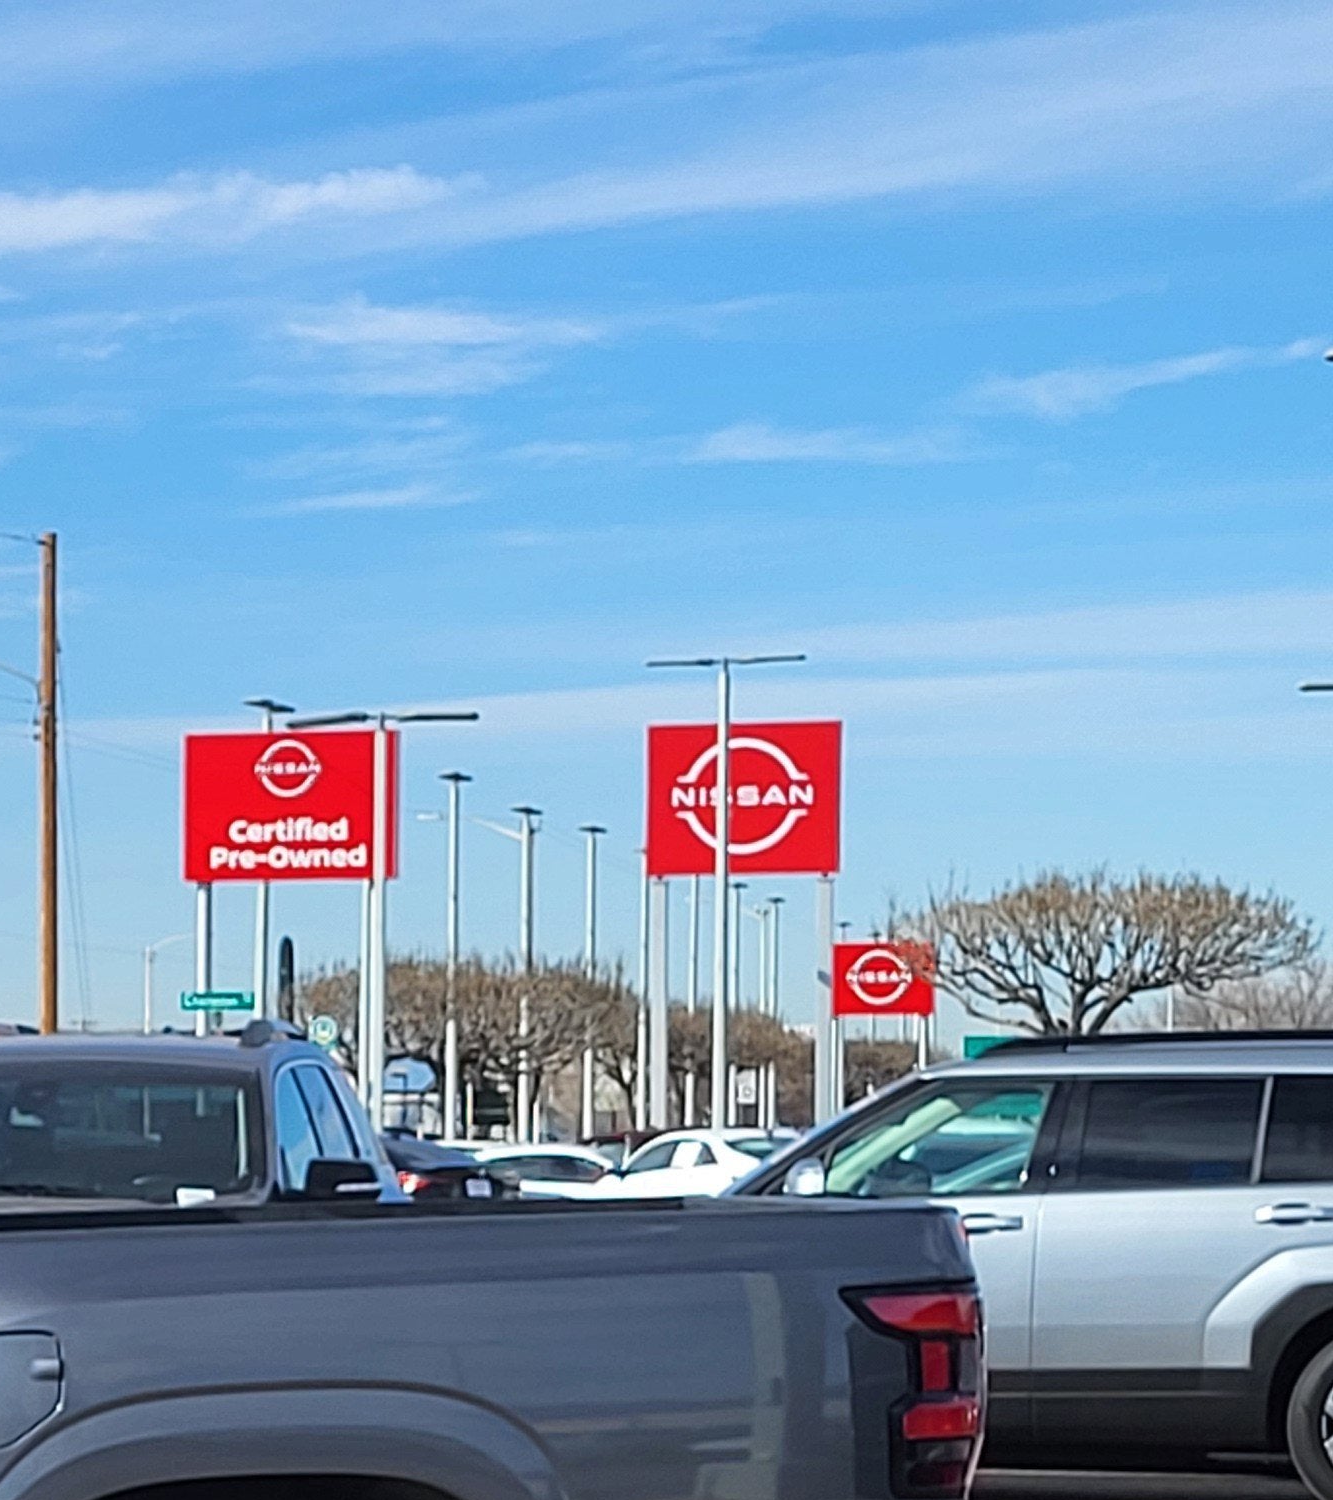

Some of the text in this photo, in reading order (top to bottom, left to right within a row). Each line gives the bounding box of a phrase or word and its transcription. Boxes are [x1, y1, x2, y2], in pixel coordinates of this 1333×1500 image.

[671, 784, 814, 807] NISSAN
[228, 815, 349, 843] Certified
[209, 842, 368, 870] Pre-Owned
